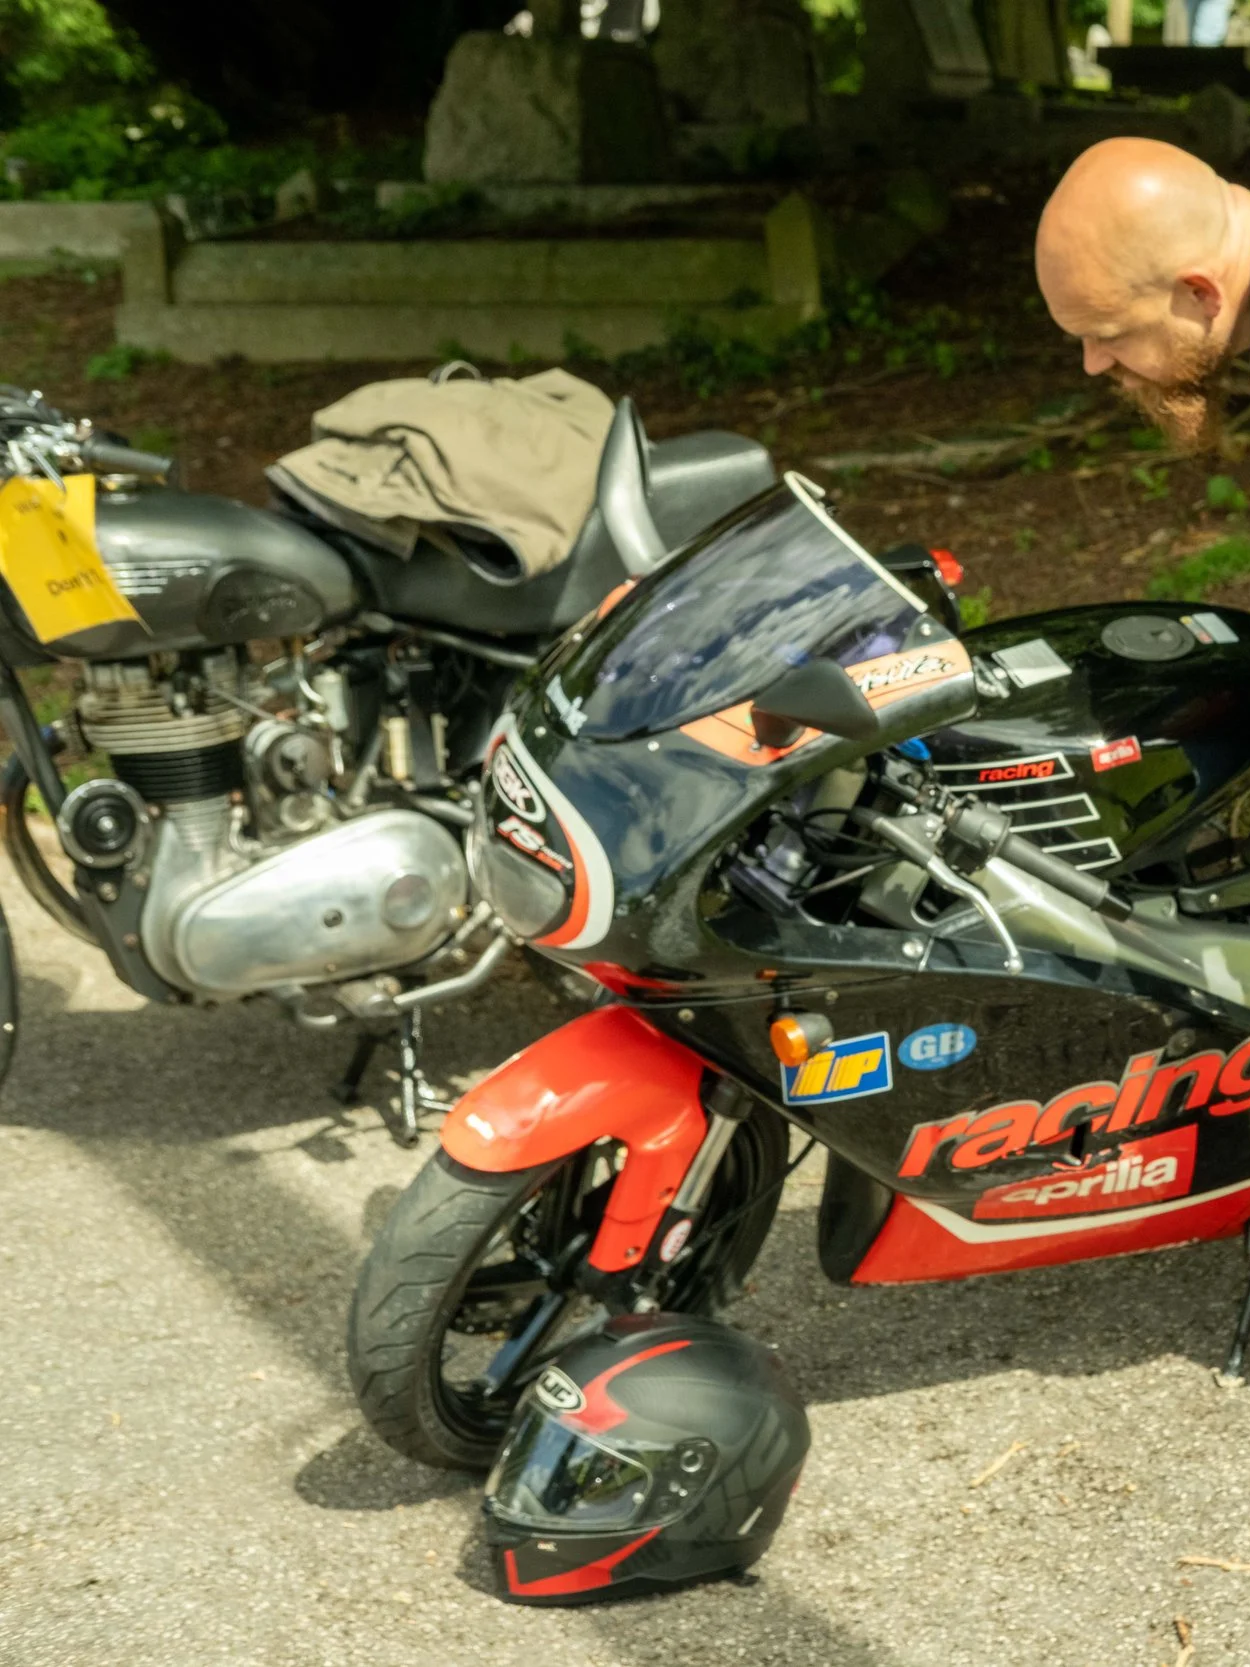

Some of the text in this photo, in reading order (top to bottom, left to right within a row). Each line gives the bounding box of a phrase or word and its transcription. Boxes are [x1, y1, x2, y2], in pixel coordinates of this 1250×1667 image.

[978, 760, 1056, 783] racing
[910, 1030, 965, 1061] GB
[1000, 1154, 1178, 1206] aprilia
